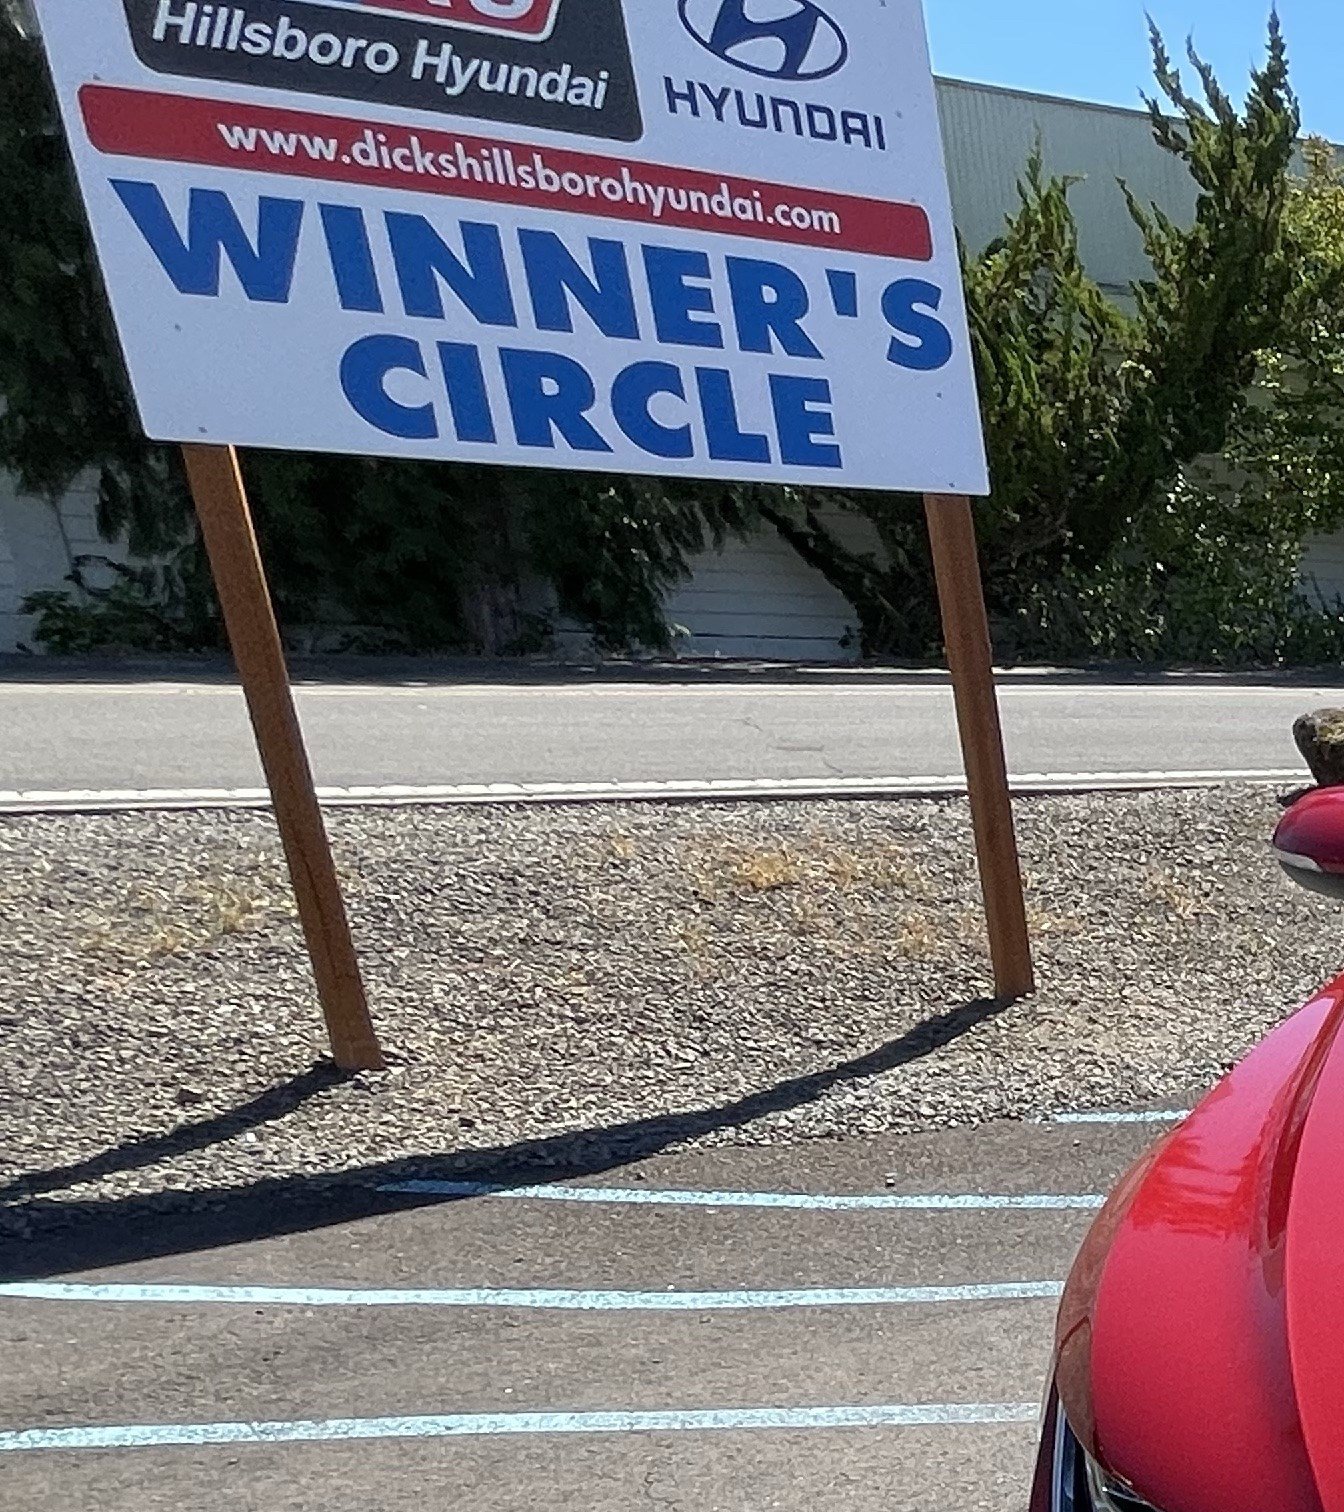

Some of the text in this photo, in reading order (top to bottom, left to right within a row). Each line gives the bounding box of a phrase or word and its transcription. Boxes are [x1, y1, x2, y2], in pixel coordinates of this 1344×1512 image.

[152, 0, 609, 110] Hillsboro Hyundai
[663, 75, 886, 150] HYUNDAI
[216, 119, 842, 235] www.dickshillsborohyundai.com
[108, 178, 952, 371] WINNER'S
[339, 333, 843, 469] CIRCLE
